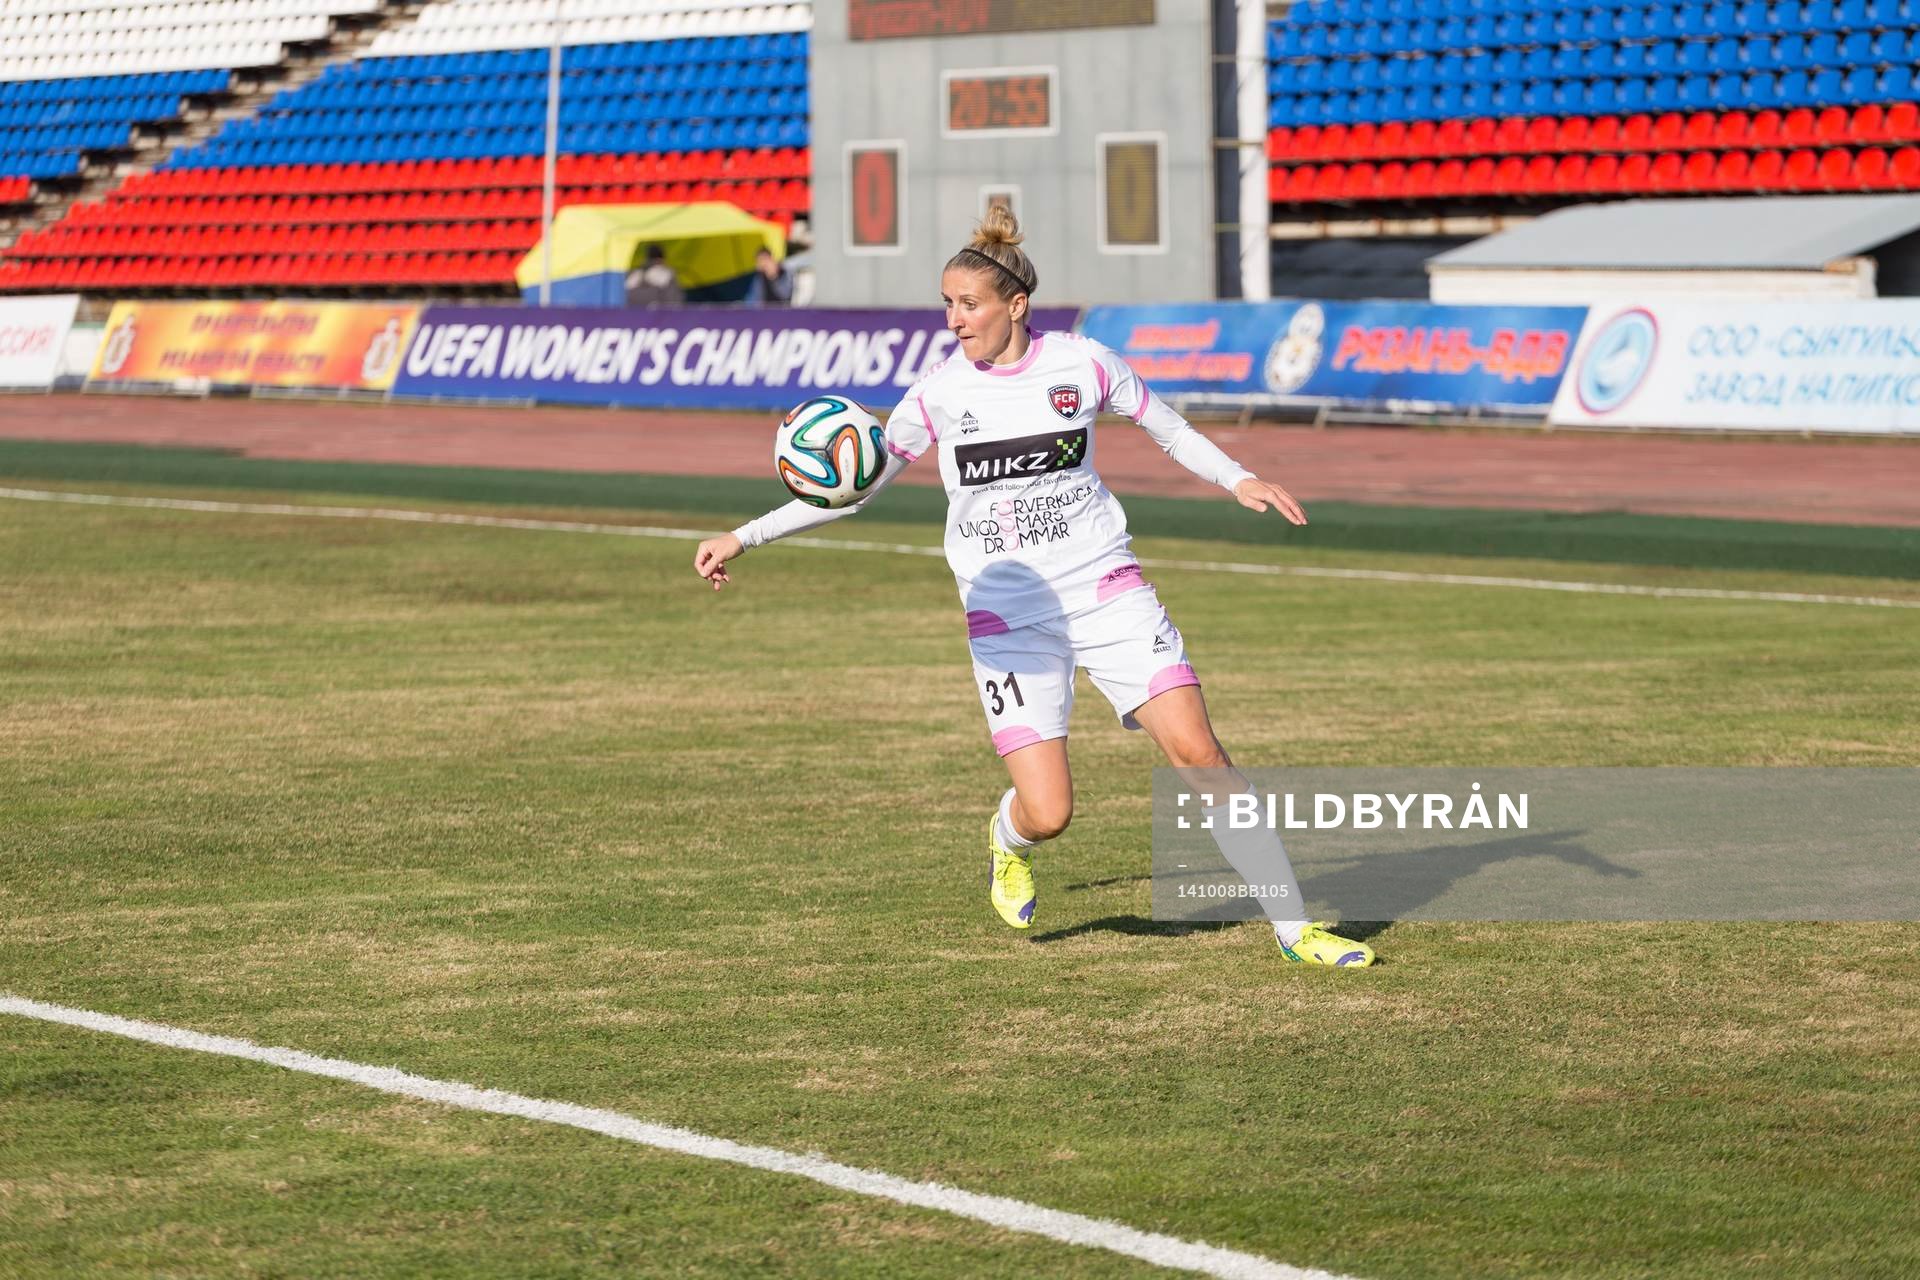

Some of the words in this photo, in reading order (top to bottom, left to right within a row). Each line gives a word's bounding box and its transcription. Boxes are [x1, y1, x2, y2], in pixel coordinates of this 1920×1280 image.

[854, 151, 894, 244] 0
[407, 324, 504, 378] UEFA
[499, 325, 679, 385] WOMEN'S
[670, 327, 906, 388] CHAMPIONS
[893, 329, 958, 387] LE
[1055, 393, 1076, 404] FCR
[1152, 645, 1172, 654] SELECT
[986, 671, 1025, 716] 31
